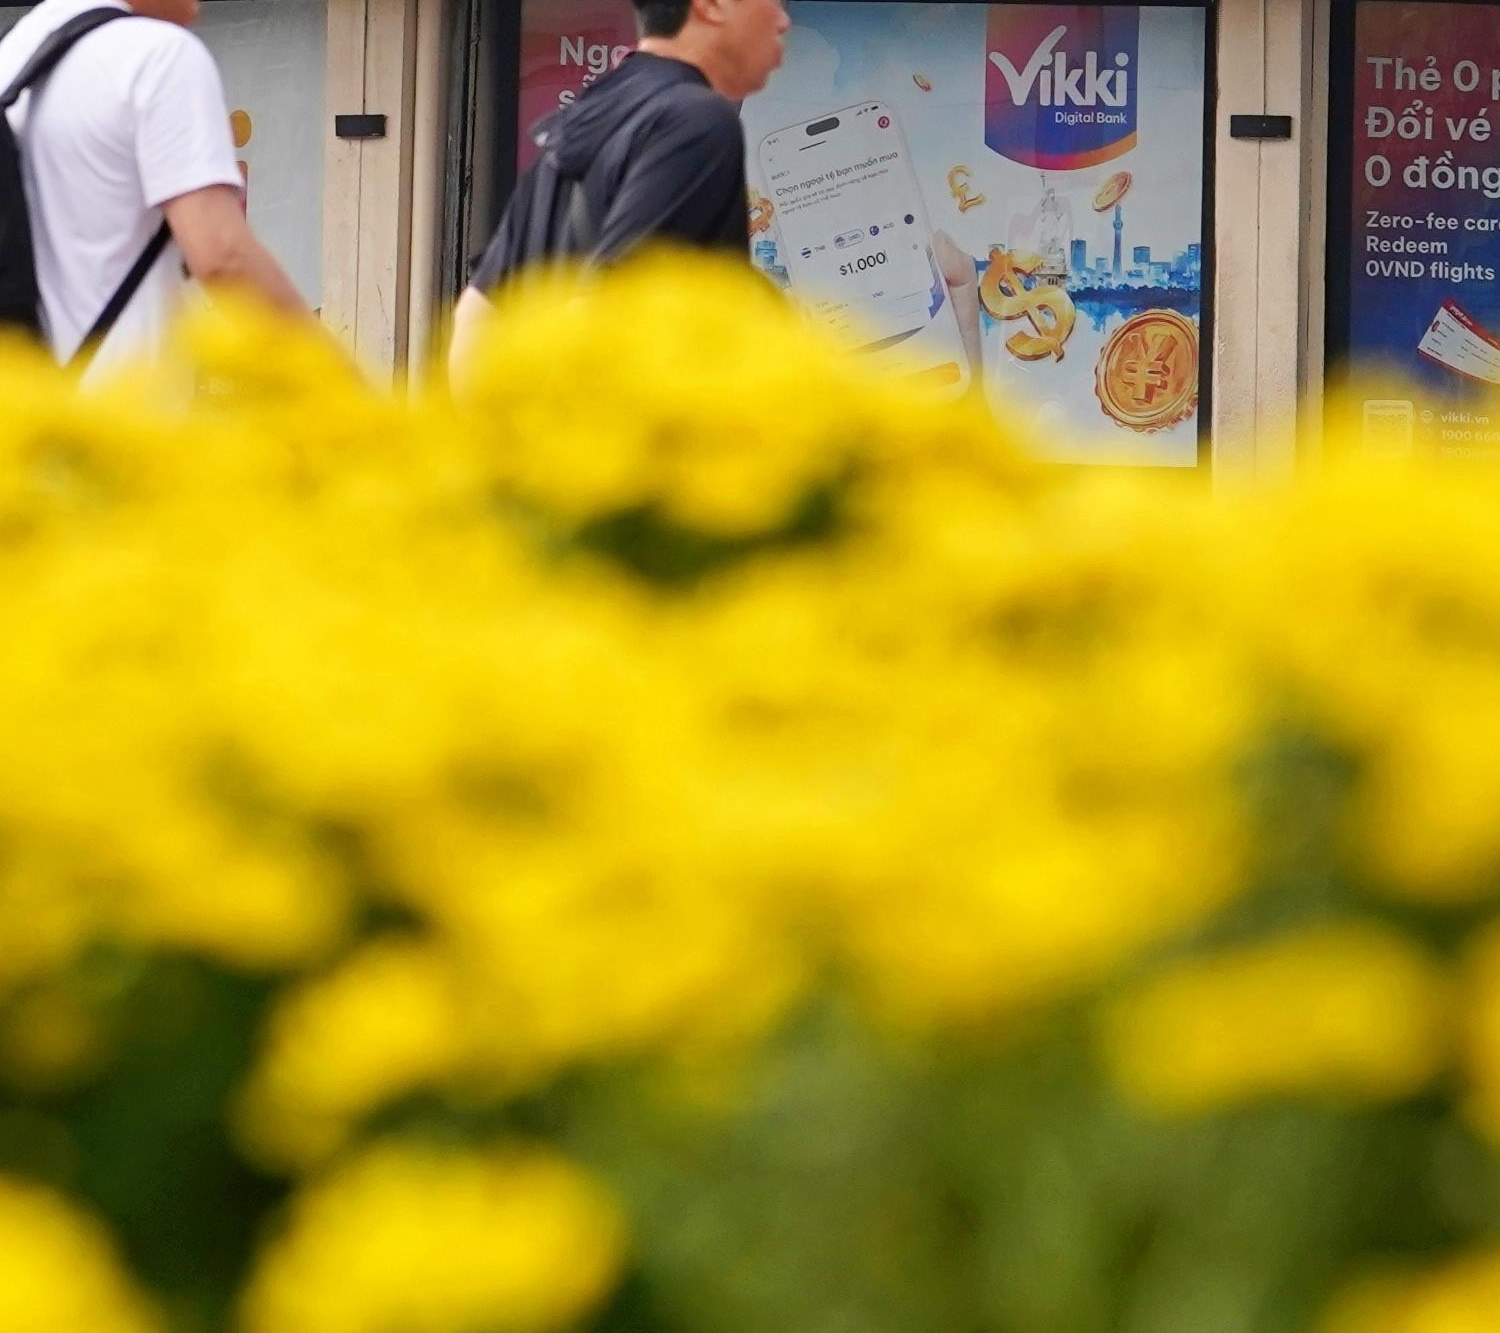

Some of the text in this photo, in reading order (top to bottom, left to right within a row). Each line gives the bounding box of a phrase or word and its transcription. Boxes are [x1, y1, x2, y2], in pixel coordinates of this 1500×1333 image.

[988, 25, 1129, 107] Vikki
[1366, 55, 1442, 92] Thẻ
[1055, 111, 1128, 126] Digital Bank
[1365, 99, 1492, 142] Đổi vé
[1366, 210, 1459, 230] Zero-fee
[1366, 235, 1448, 255] Redeem
[1430, 261, 1495, 283] flights
